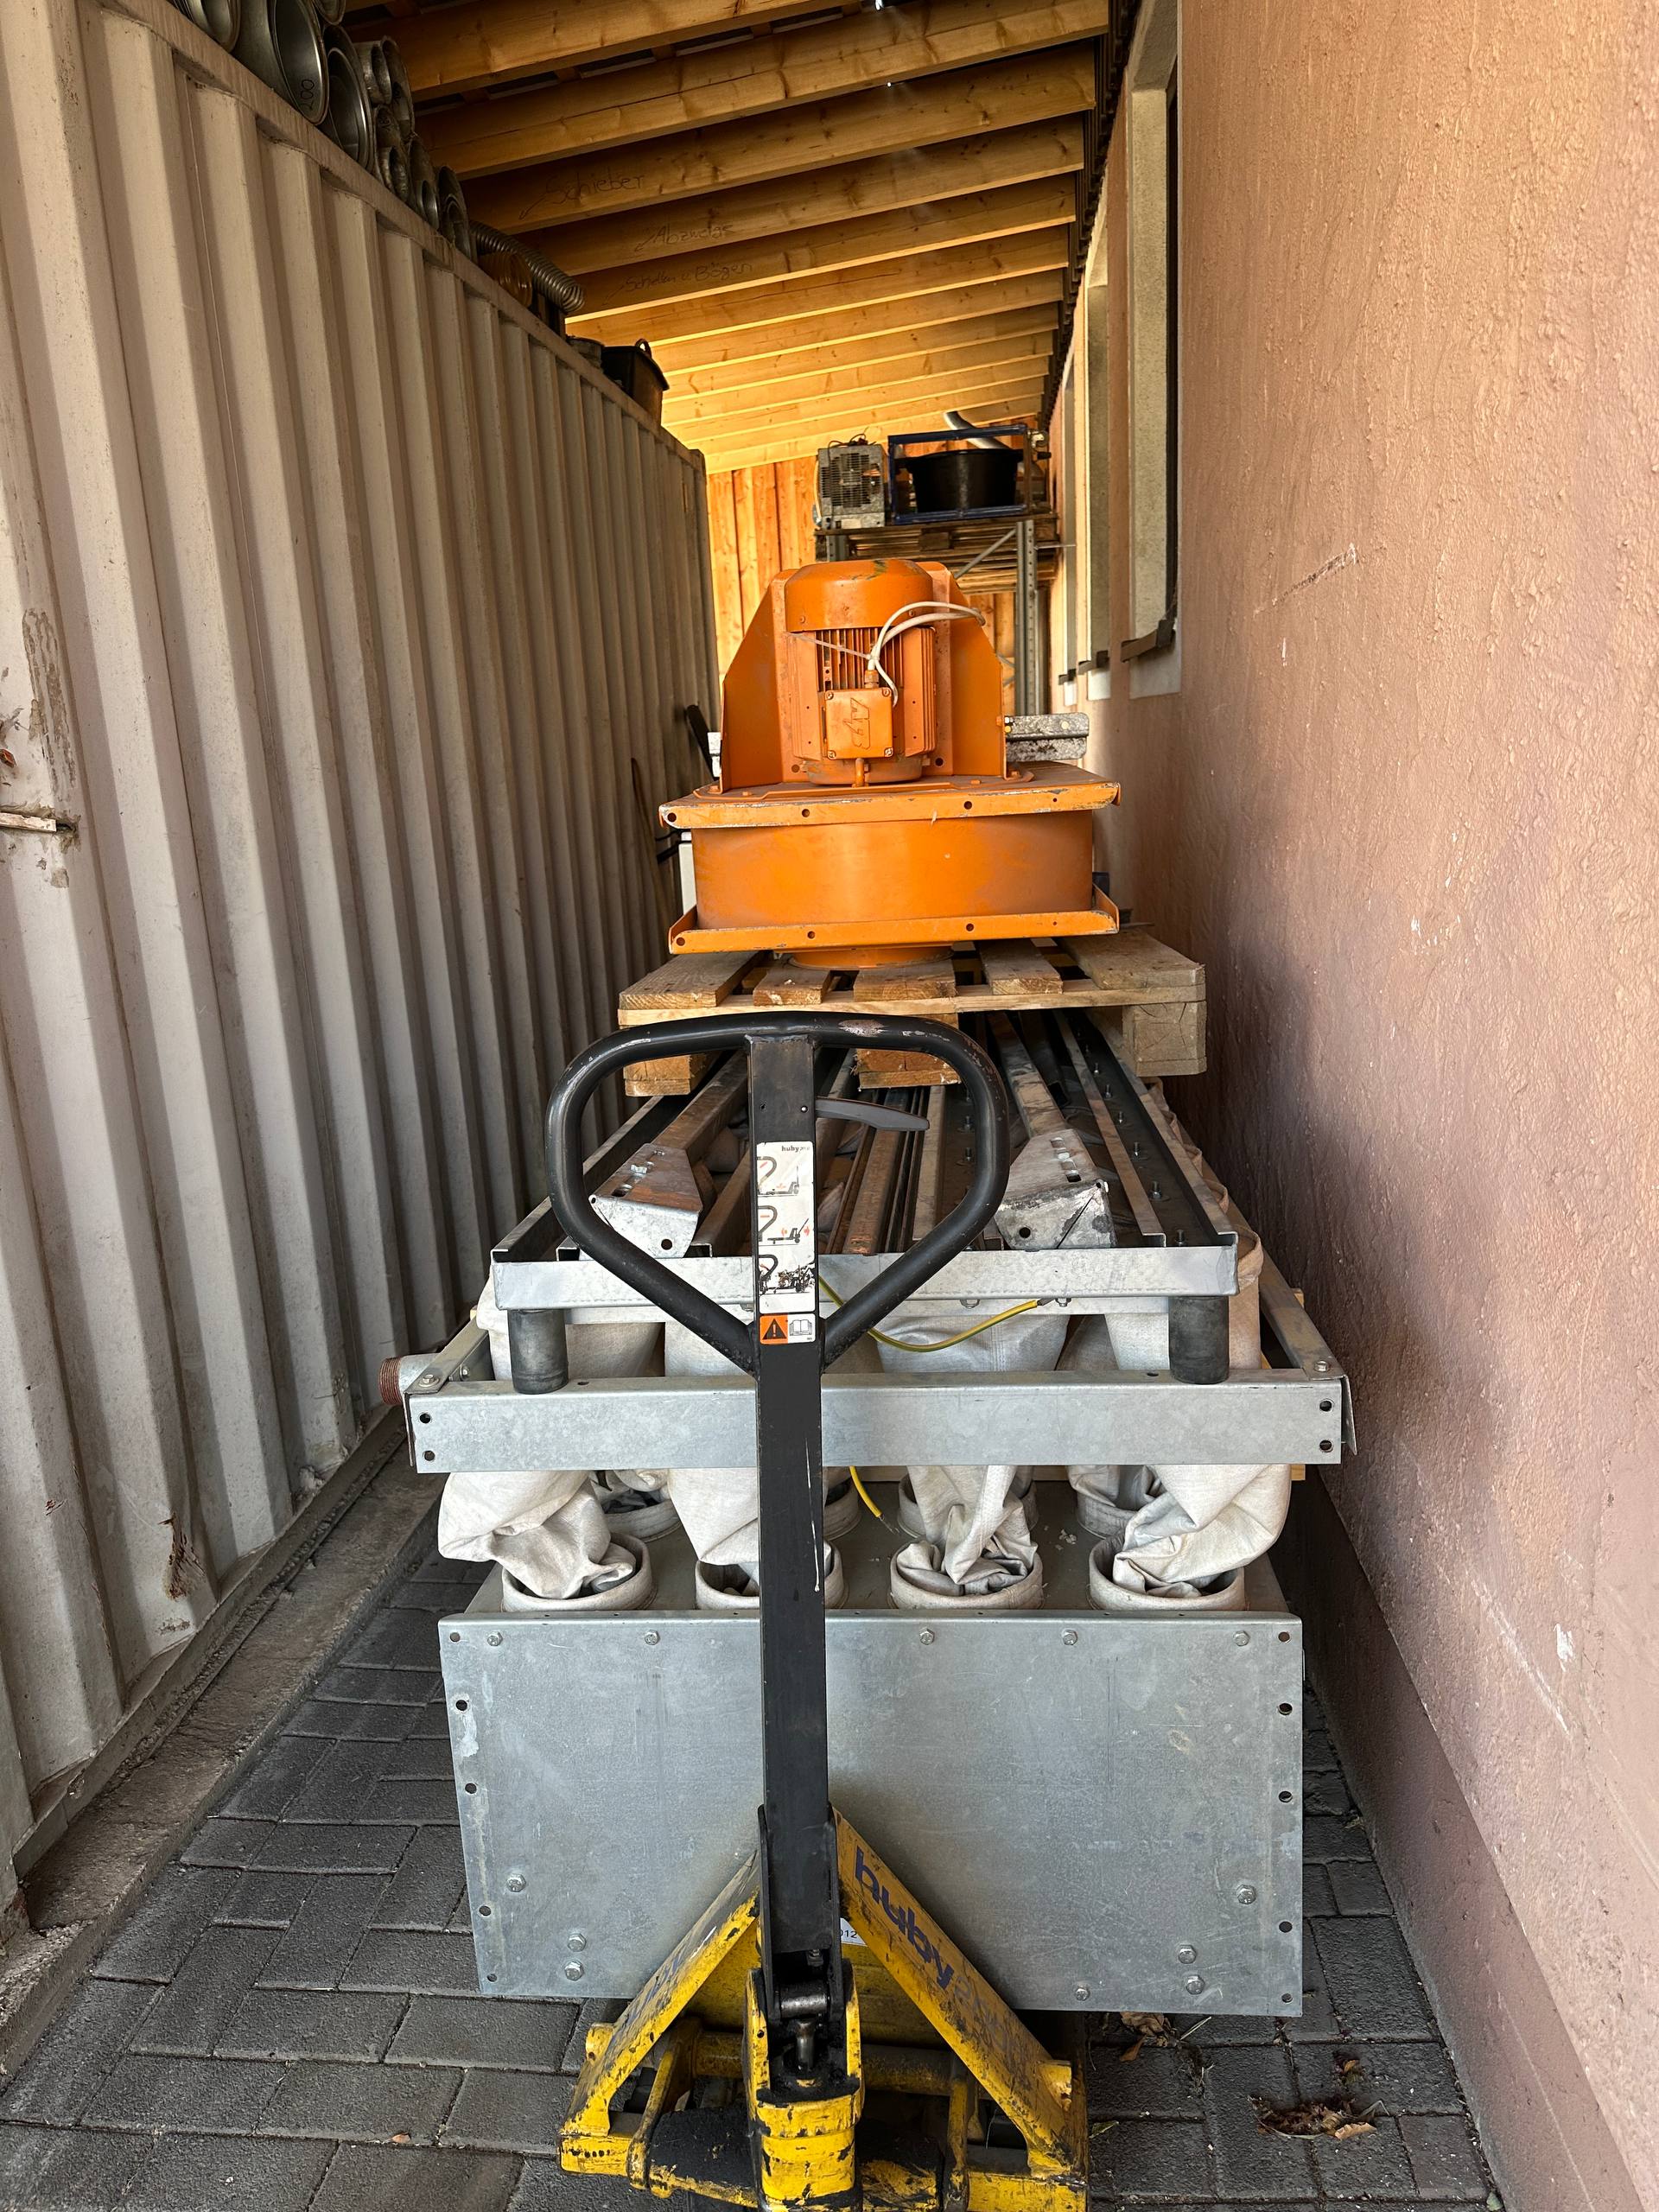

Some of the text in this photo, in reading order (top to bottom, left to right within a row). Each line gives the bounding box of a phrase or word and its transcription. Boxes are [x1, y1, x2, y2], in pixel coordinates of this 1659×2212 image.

[546, 166, 645, 205] Schieber
[695, 262, 753, 282] Bögen
[855, 1846, 954, 1990] huby
